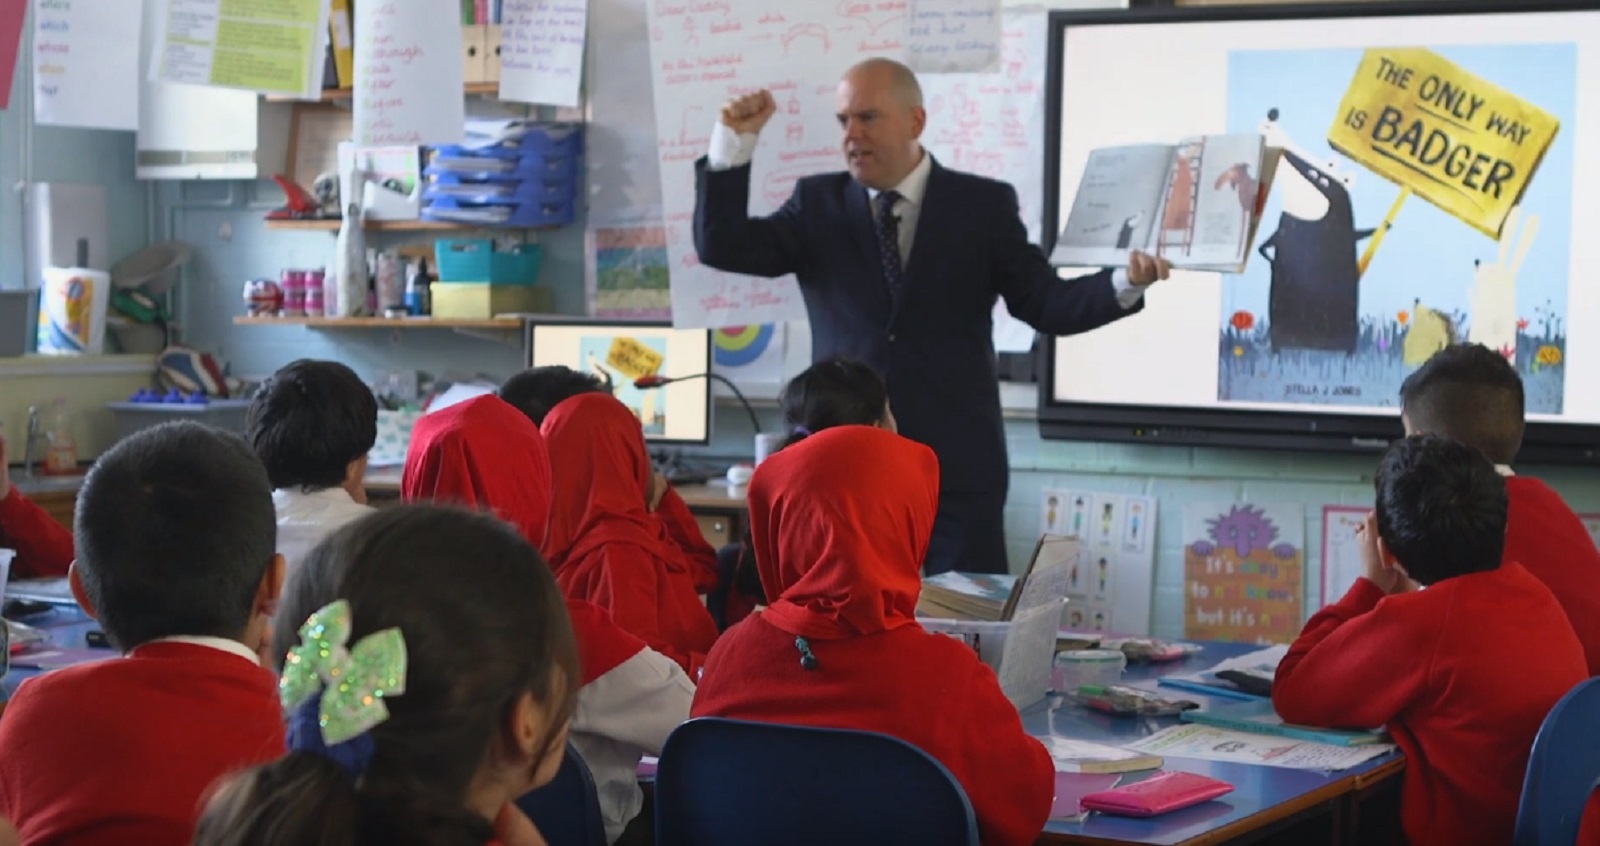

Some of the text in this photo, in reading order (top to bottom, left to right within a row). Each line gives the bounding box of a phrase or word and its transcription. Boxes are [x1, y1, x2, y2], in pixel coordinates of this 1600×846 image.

[1376, 57, 1532, 147] THE ONLY WAY
[1344, 104, 1516, 200] IS BADGER
[1285, 384, 1362, 397] STELLA J JONES
[1206, 555, 1234, 574] It's
[1192, 581, 1209, 598] to
[1197, 607, 1223, 625] but
[1230, 606, 1256, 627] it's
